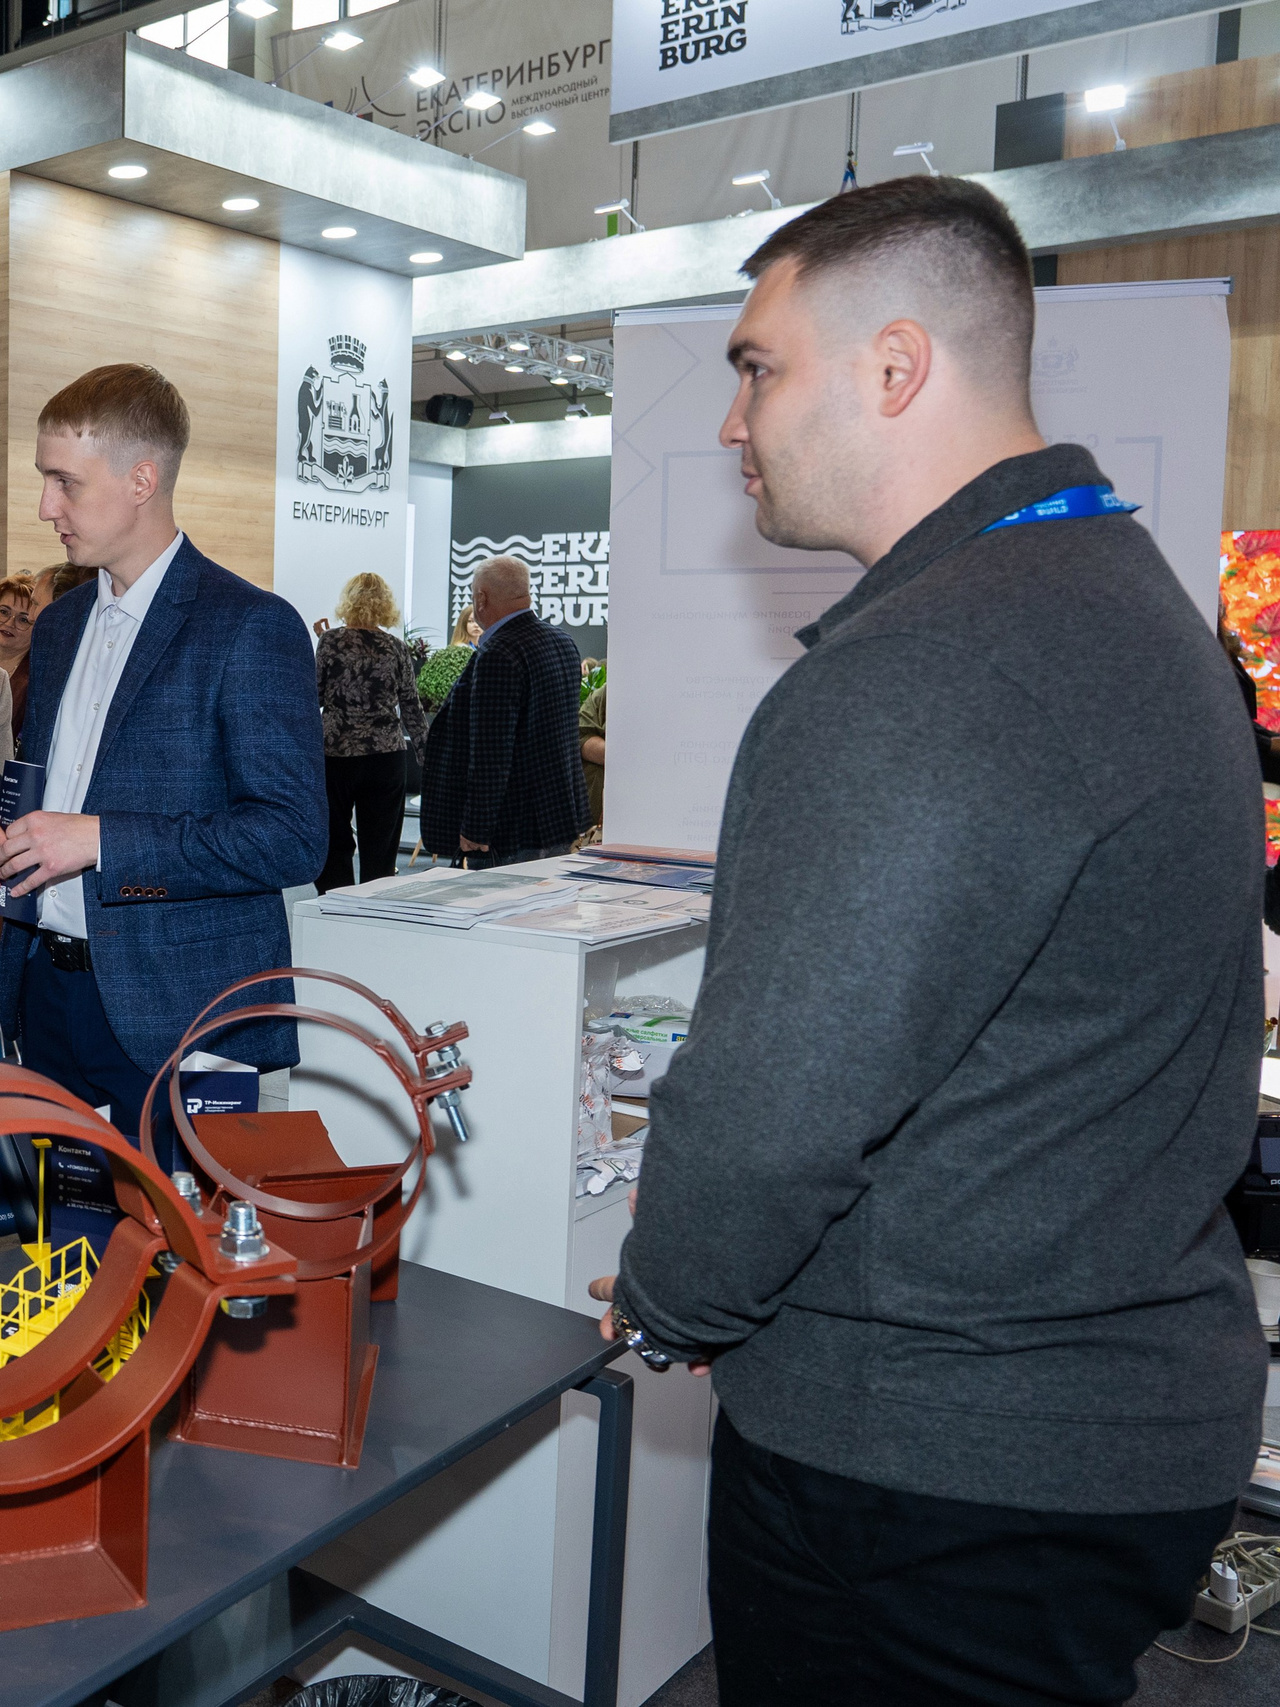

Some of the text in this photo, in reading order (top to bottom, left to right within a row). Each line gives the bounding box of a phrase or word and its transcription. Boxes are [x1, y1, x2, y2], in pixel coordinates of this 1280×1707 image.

[660, 1, 748, 45] ERIN
[659, 28, 747, 71] BURG
[417, 38, 611, 113] ЕКАТЕРИНБУРГ
[511, 75, 598, 106] МЕЖДУНАРОДНЫЙ
[511, 87, 610, 120] ВЫСТАВОЧНЫЙ ЦЕНТР
[417, 99, 506, 142] ЭКСПО
[293, 501, 390, 528] ЕКАТЕРИНБУРГ
[640, 1030, 668, 1038] салфетки
[58, 1145, 91, 1156] Контакты
